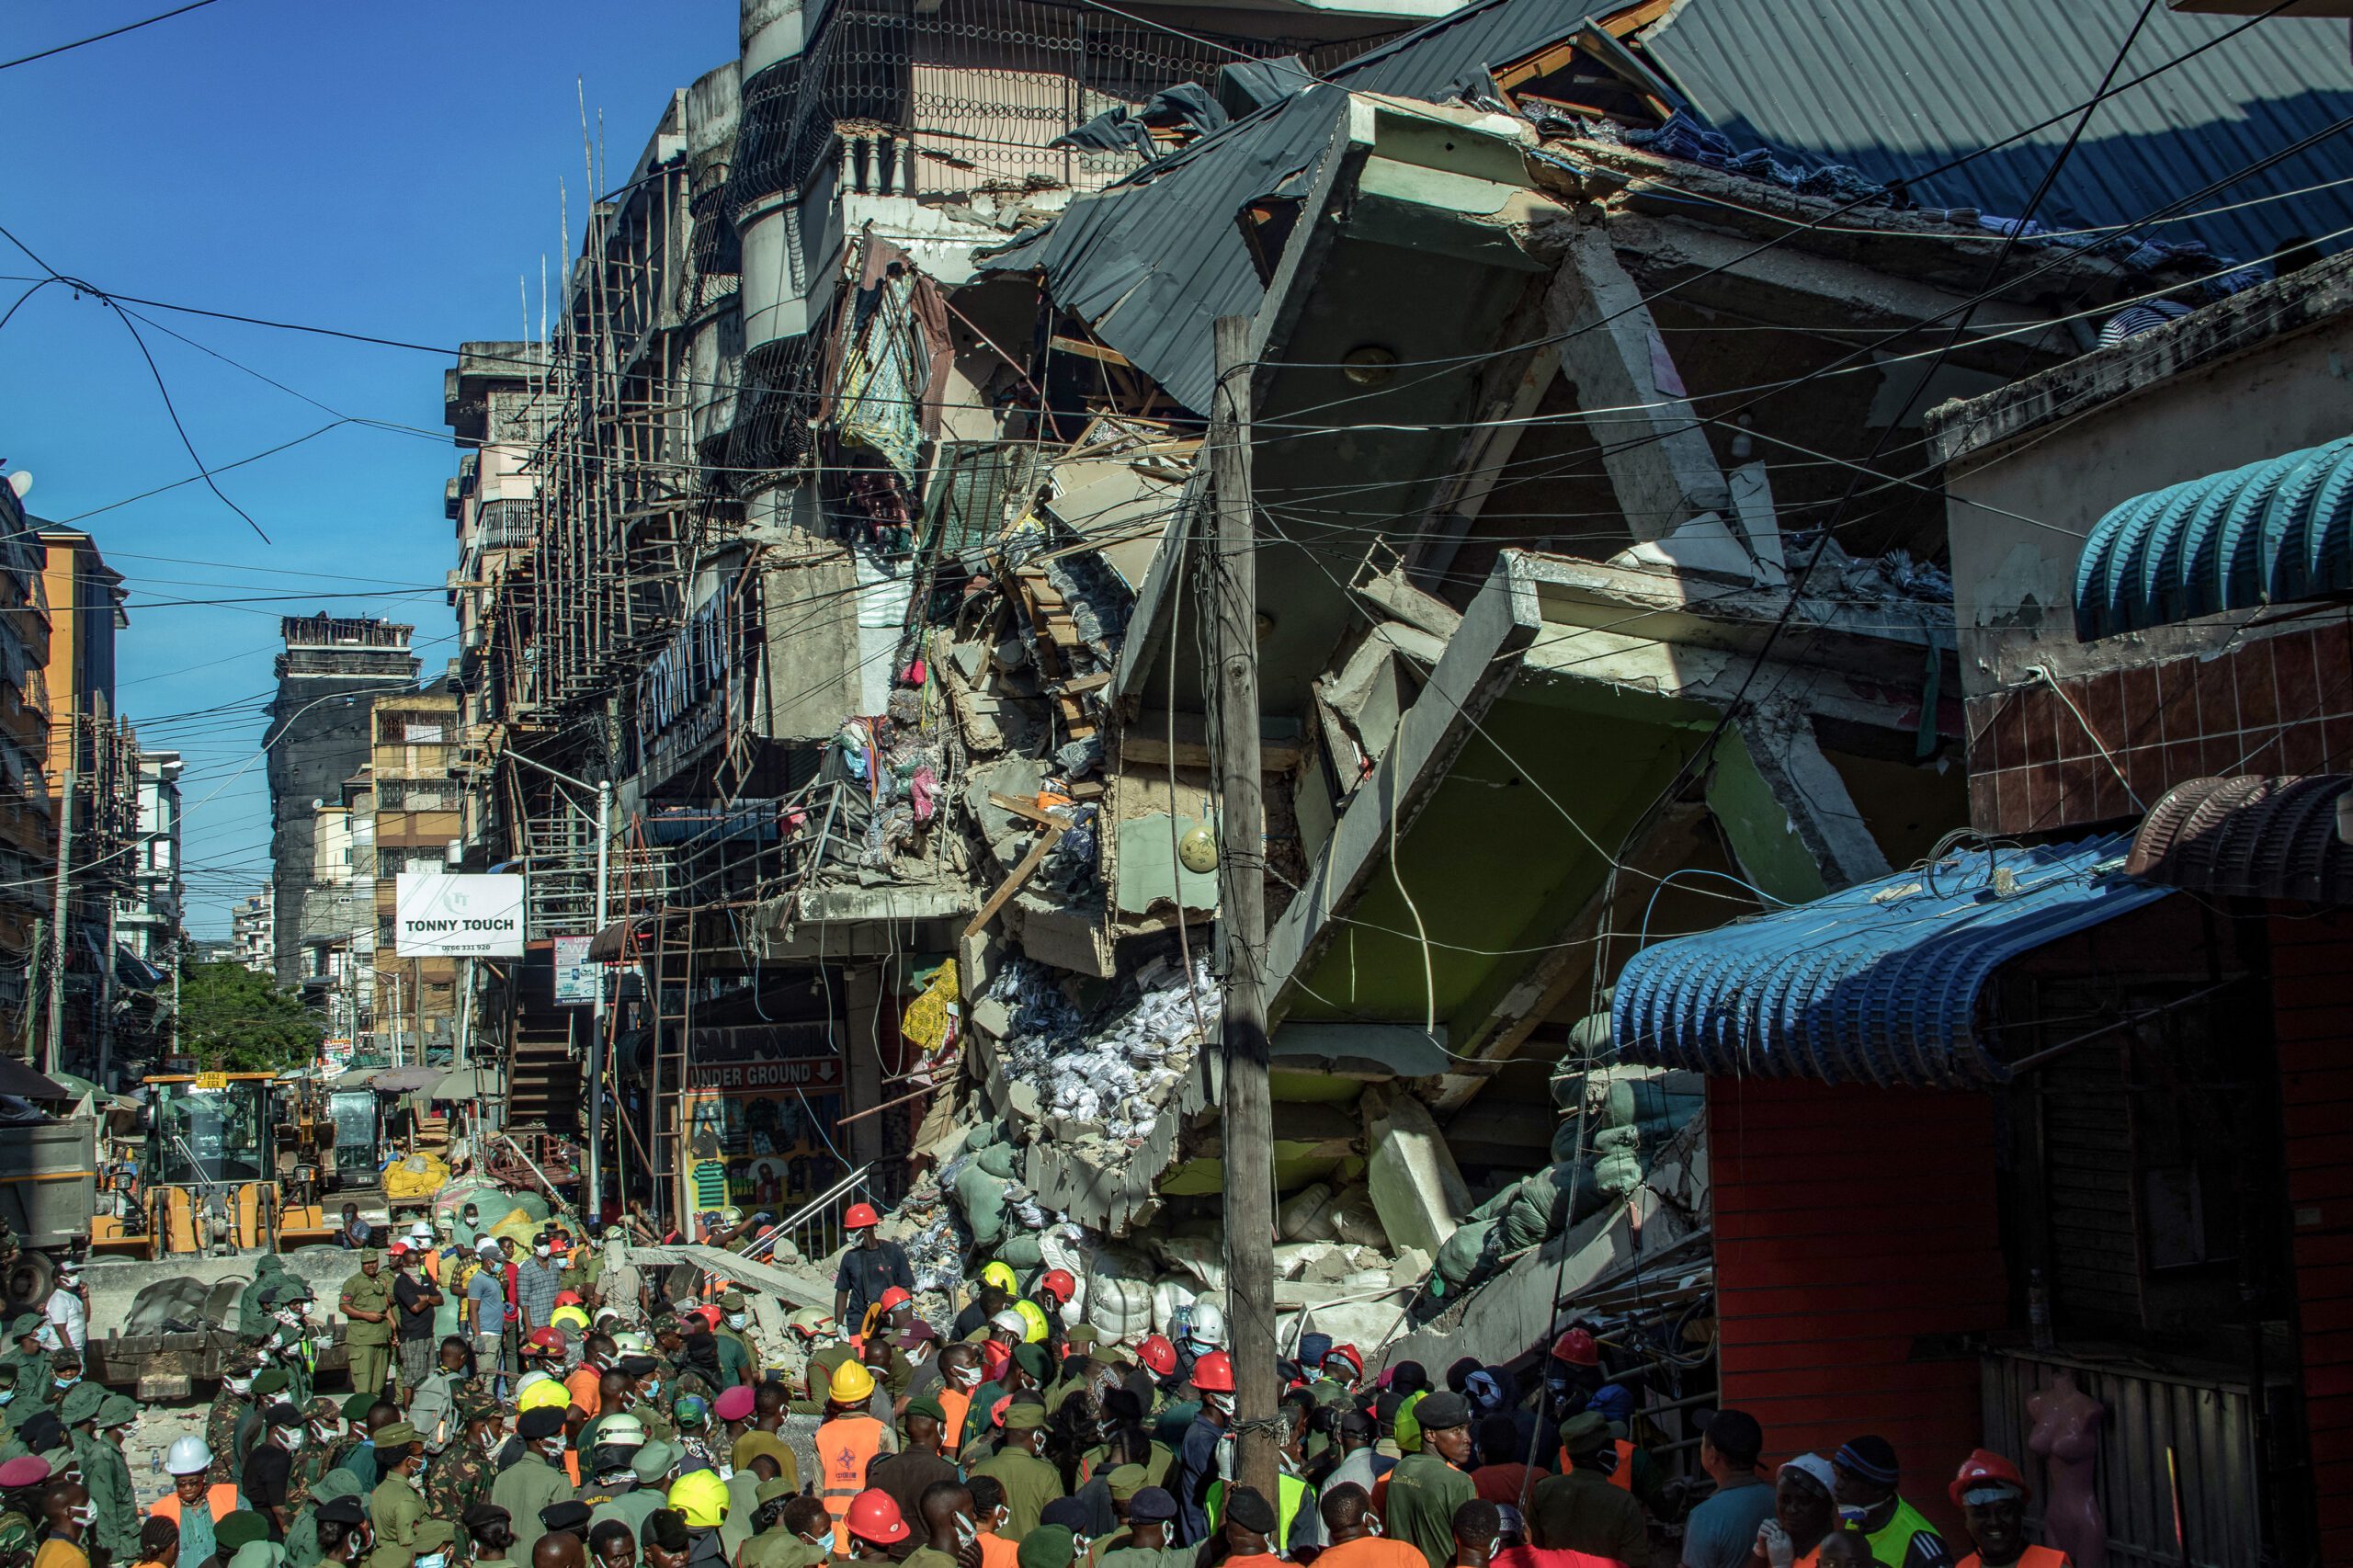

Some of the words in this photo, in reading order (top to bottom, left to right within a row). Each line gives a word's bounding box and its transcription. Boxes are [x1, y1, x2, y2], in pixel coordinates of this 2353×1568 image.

[405, 920, 458, 932] TONNY
[463, 919, 514, 930] TOUCH
[689, 1024, 838, 1064] CALIFORNIA
[690, 1067, 743, 1088] UNDER
[746, 1064, 811, 1086] GROUND
